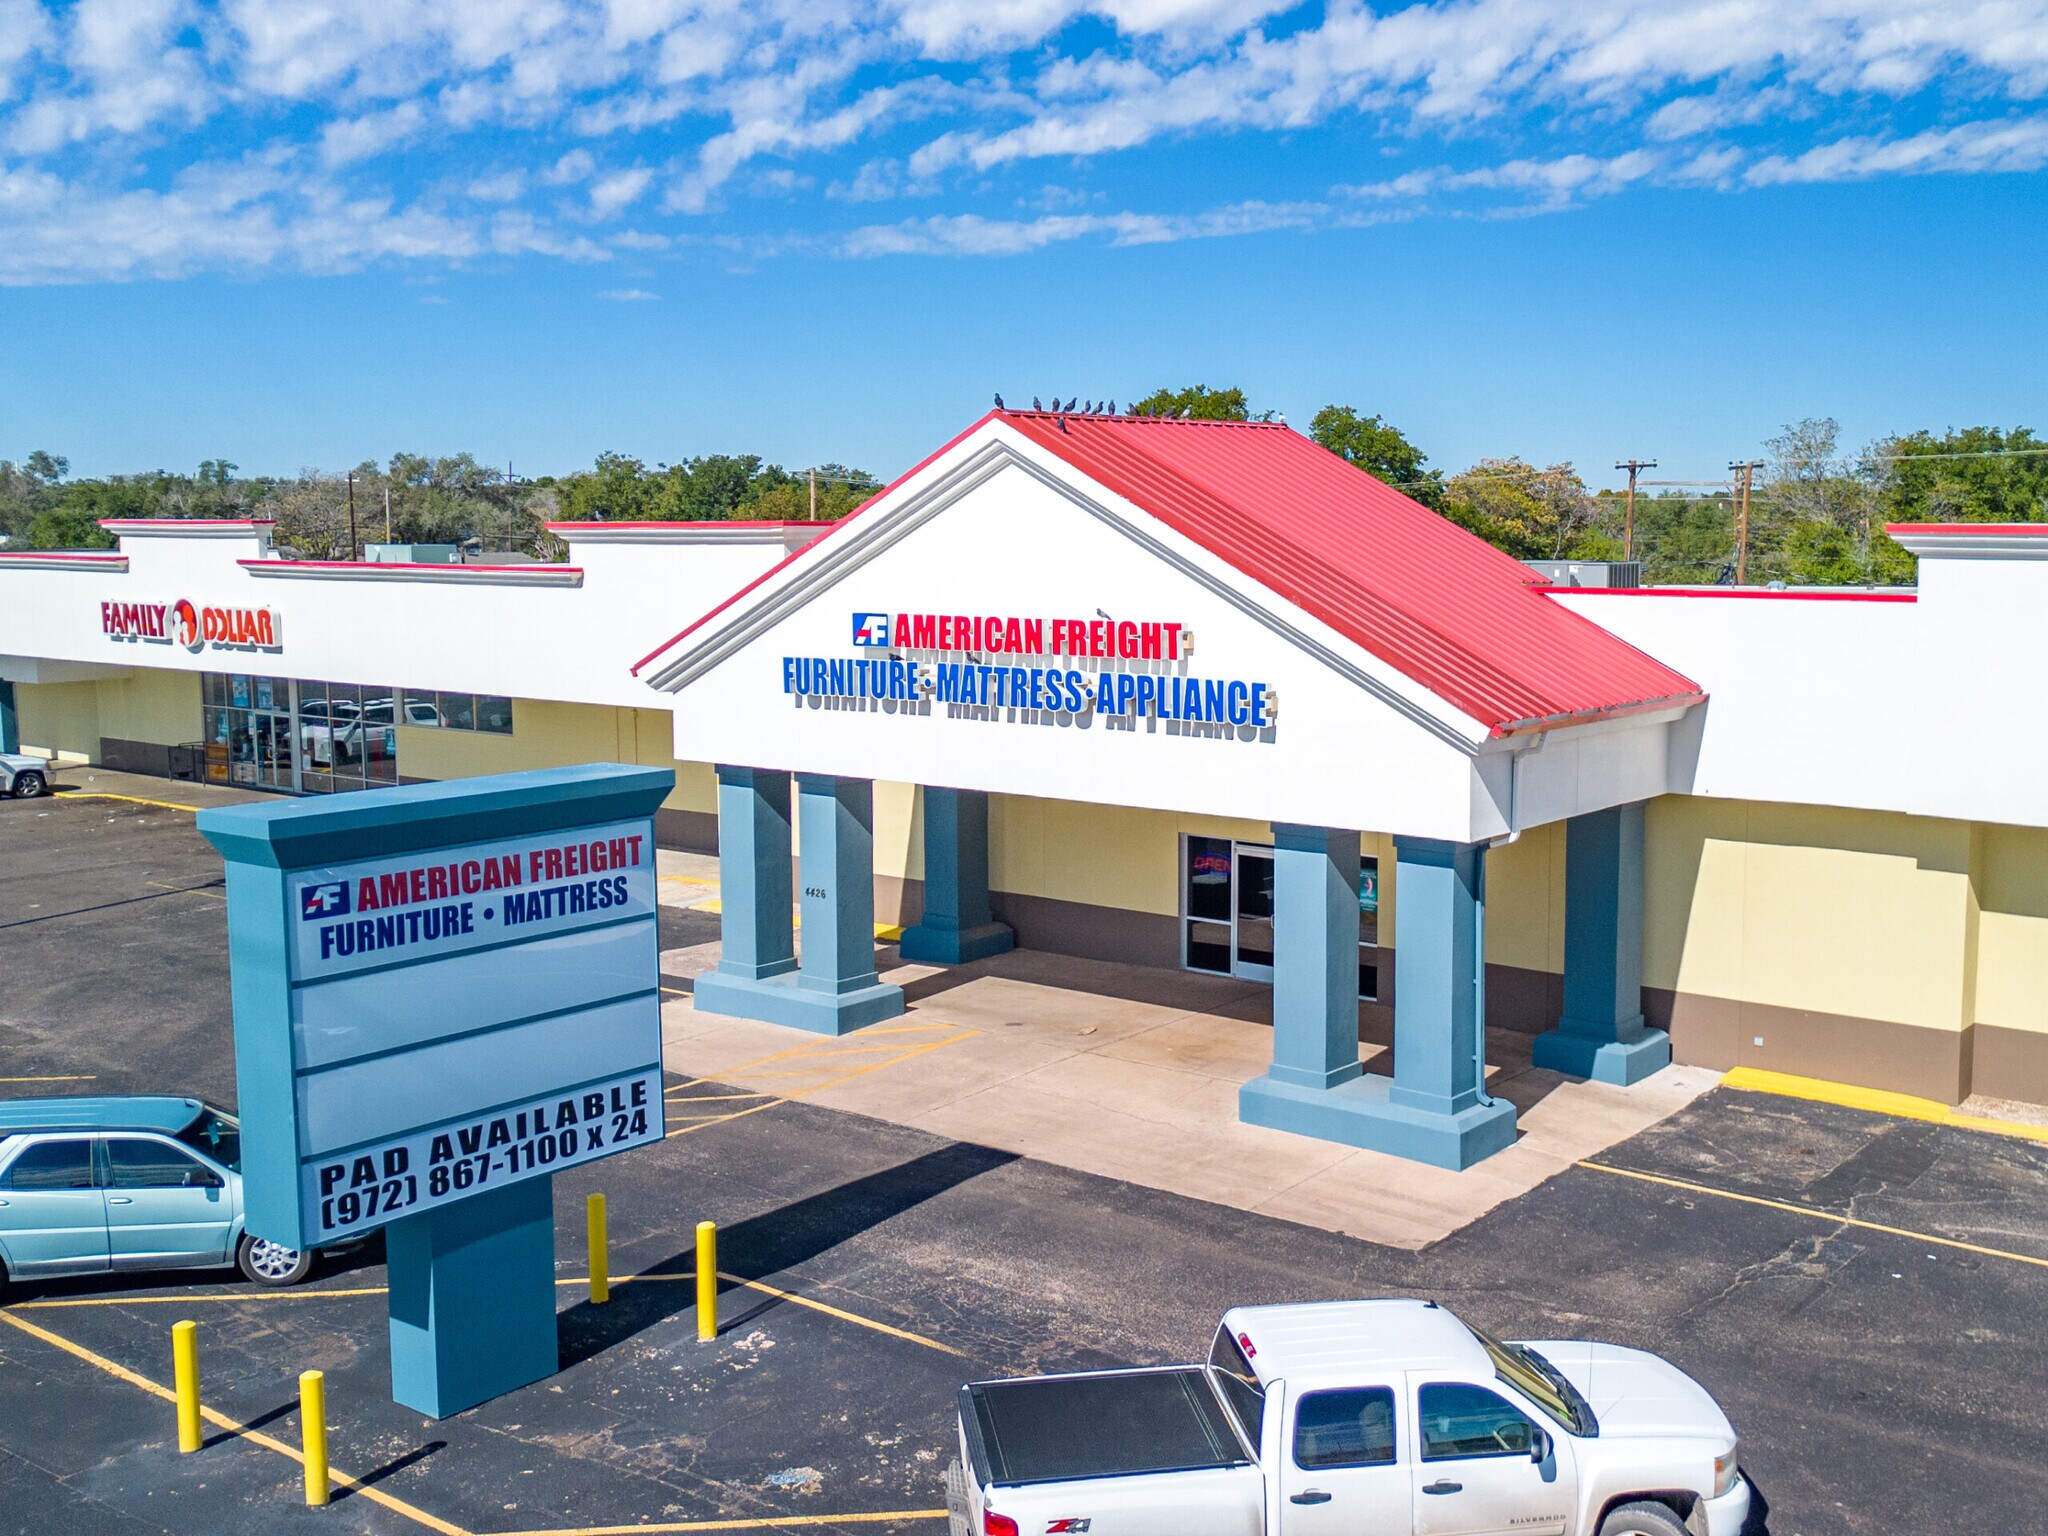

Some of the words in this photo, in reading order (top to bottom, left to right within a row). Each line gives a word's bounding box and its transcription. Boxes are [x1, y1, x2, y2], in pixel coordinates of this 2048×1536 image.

[101, 602, 167, 638] FAMILY
[202, 607, 274, 646] DOLLAR
[894, 613, 1043, 655] AMERICAN
[1052, 619, 1183, 661] FREIGHT
[783, 656, 920, 700] FURNITURE
[936, 662, 1083, 713] MATTRESS
[1096, 672, 1268, 728] APPLIANCE
[357, 854, 522, 913] AMERICAN
[529, 835, 643, 883] FREIGHT
[805, 887, 826, 899] 4426
[320, 902, 474, 960] FURNITURE
[503, 875, 628, 926] MATTRESS
[320, 1146, 409, 1198] PAD
[429, 1080, 648, 1166] AVAILABLE
[429, 1128, 578, 1198] 867-1100
[612, 1108, 648, 1144] 24
[1510, 1514, 1566, 1525] SILVERADO
